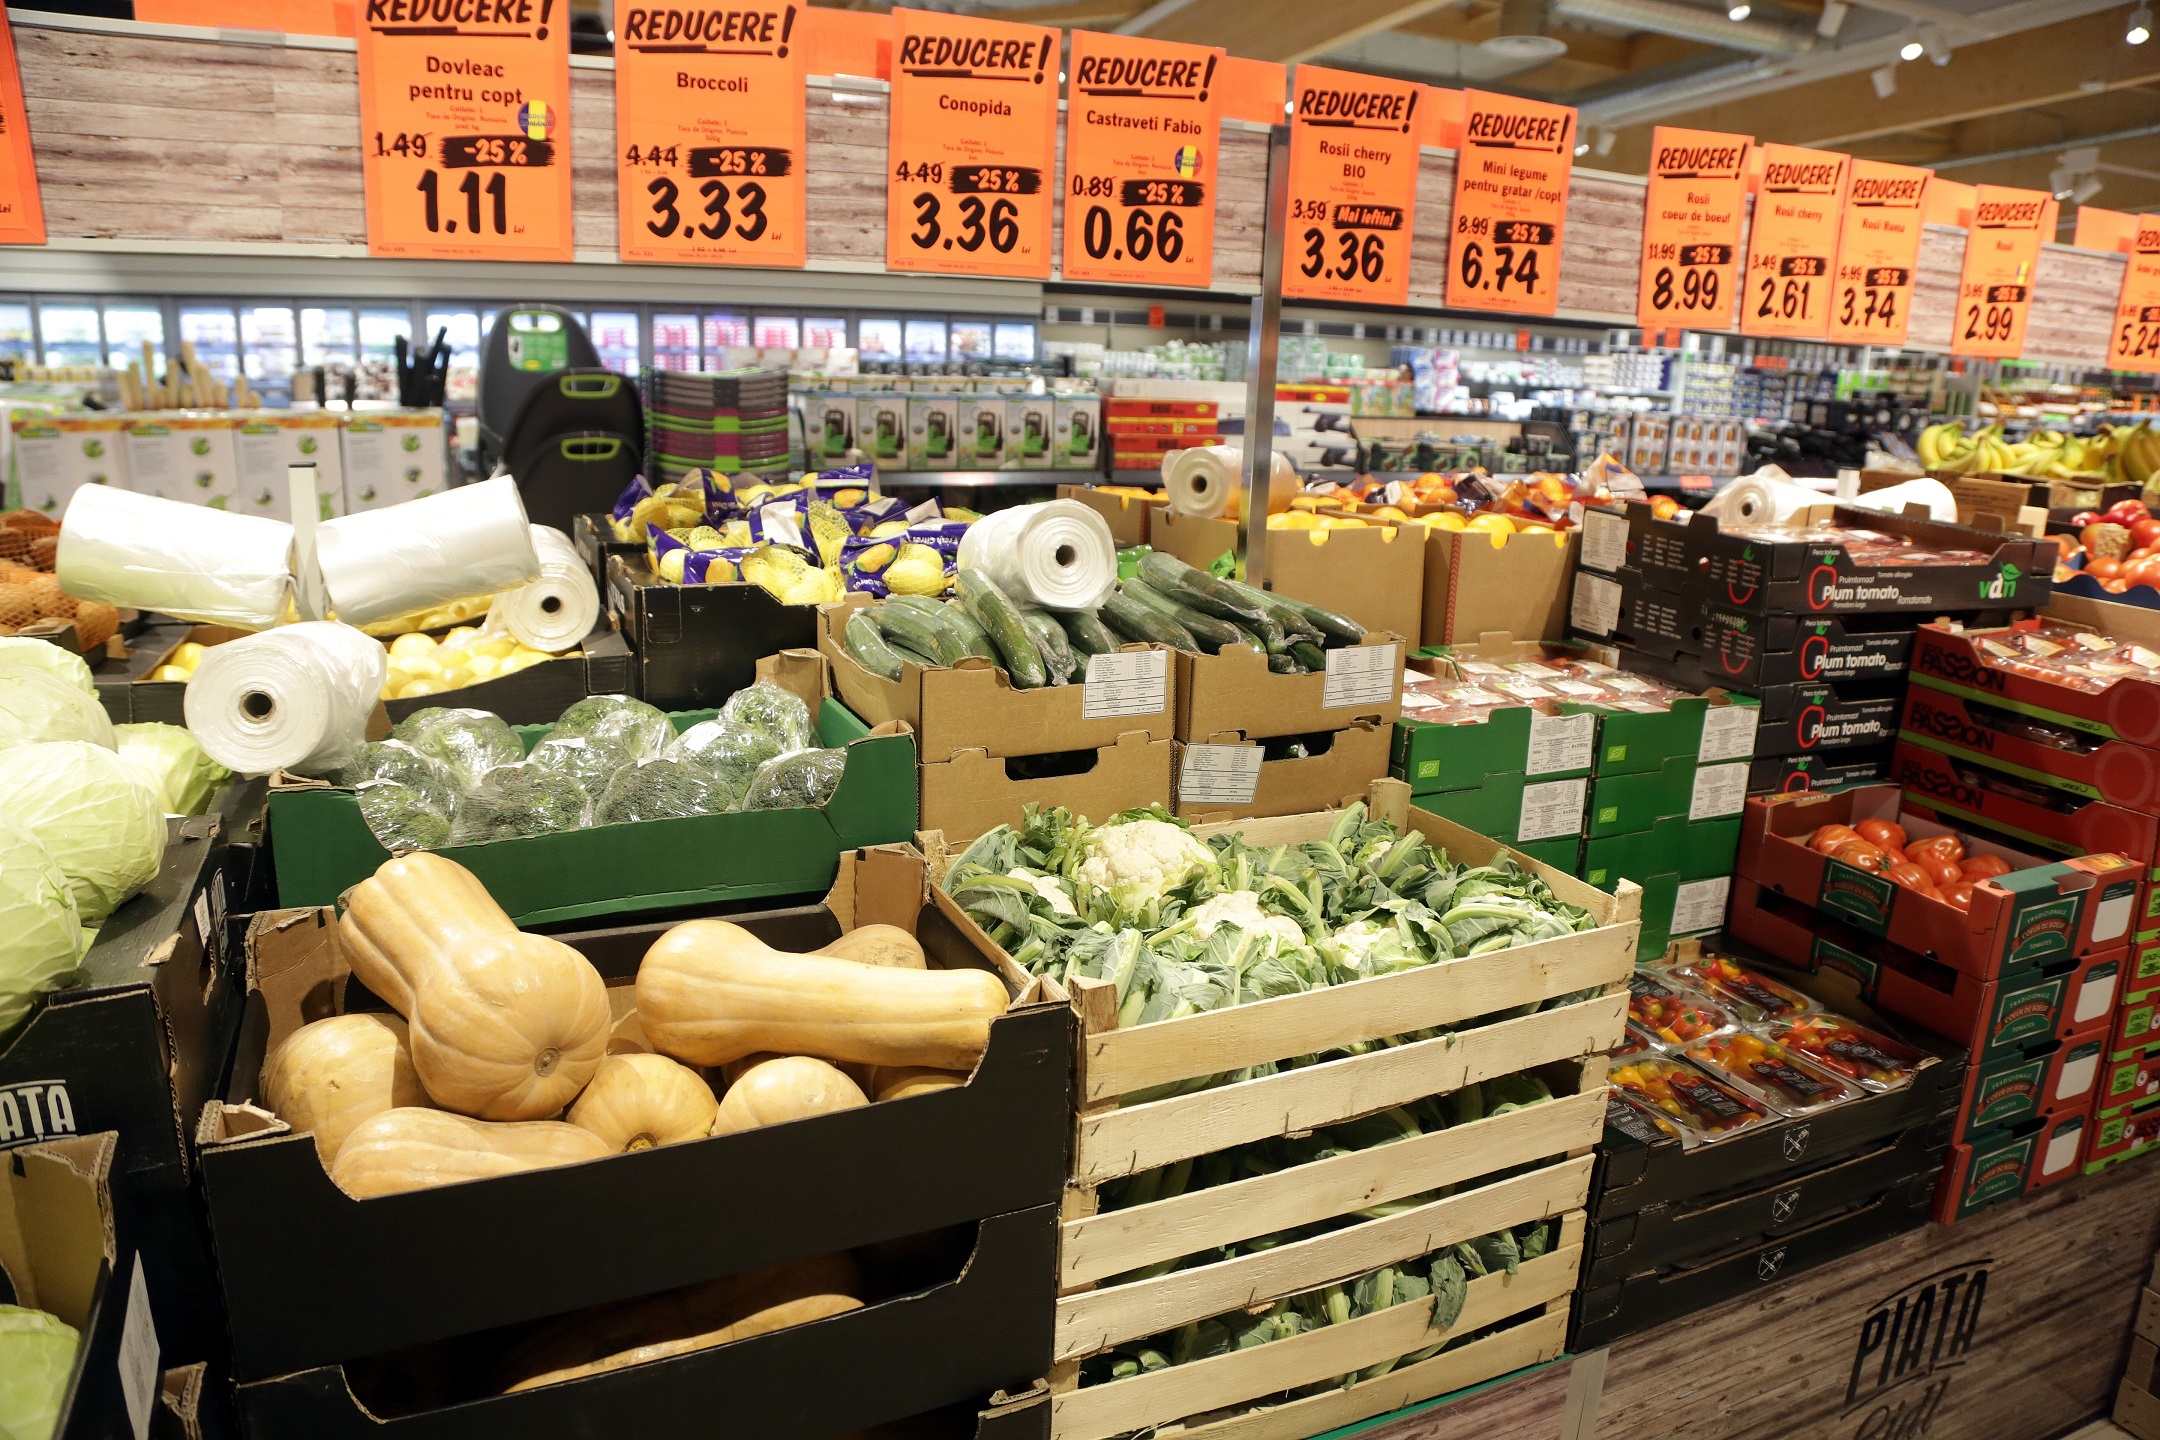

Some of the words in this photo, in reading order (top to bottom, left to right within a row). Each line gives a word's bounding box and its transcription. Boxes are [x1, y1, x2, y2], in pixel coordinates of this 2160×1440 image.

[624, 4, 797, 58] REDUCERE!
[426, 55, 504, 77] Dovleac
[900, 34, 1052, 84] REDUCERE!
[677, 72, 748, 92] Broccoli
[1077, 54, 1217, 101] REDUCERE!
[409, 84, 473, 101] pentru
[482, 88, 522, 106] copt
[939, 94, 1011, 116] Conopida
[1087, 110, 1158, 131] Castraveti
[1164, 117, 1201, 135] Fabio
[1299, 89, 1418, 134] REDUCERE!
[375, 132, 427, 157] 1.49
[1468, 112, 1571, 154] REDUCERE!
[627, 145, 678, 167] 4.44
[1320, 140, 1350, 157] Rosii
[1354, 146, 1391, 164] cherry
[1658, 142, 1748, 180] REDUCERE!
[897, 161, 942, 183] 4.49
[1343, 164, 1365, 178] BIO
[1483, 160, 1507, 175] Mini
[1510, 164, 1547, 181] legume
[1764, 160, 1843, 196] REDUCERE!
[1073, 175, 1113, 197] 0.89
[1464, 179, 1498, 193] pentru
[1502, 185, 1532, 199] gratar
[1688, 192, 1710, 204] Rosii
[1852, 175, 1928, 209] REDUCERE!
[417, 169, 506, 234] 1.11
[647, 177, 767, 241] 3.33
[1294, 199, 1327, 221] 3.59
[1776, 205, 1796, 217] Rosii
[911, 191, 1018, 253] 3.36
[1338, 206, 1360, 223] Mai
[1458, 215, 1488, 235] 8.99
[1663, 210, 1688, 221] coeur
[1692, 212, 1701, 222] de
[1084, 205, 1183, 263] 0.66
[1301, 227, 1384, 282] 3.36
[1462, 241, 1539, 294] 6.74
[1652, 267, 1719, 311] 8.99
[1758, 277, 1810, 319] 2.61
[1841, 288, 1895, 328] 3.74
[1965, 305, 2013, 341] 2.99
[1839, 576, 1875, 584] Pruimtomaat
[1822, 586, 1854, 601] Plum
[1857, 586, 1899, 600] tomato
[1814, 654, 1843, 669] Plum
[1847, 653, 1886, 667] tomato
[1811, 722, 1839, 738] Plum
[1843, 720, 1881, 736] tomato
